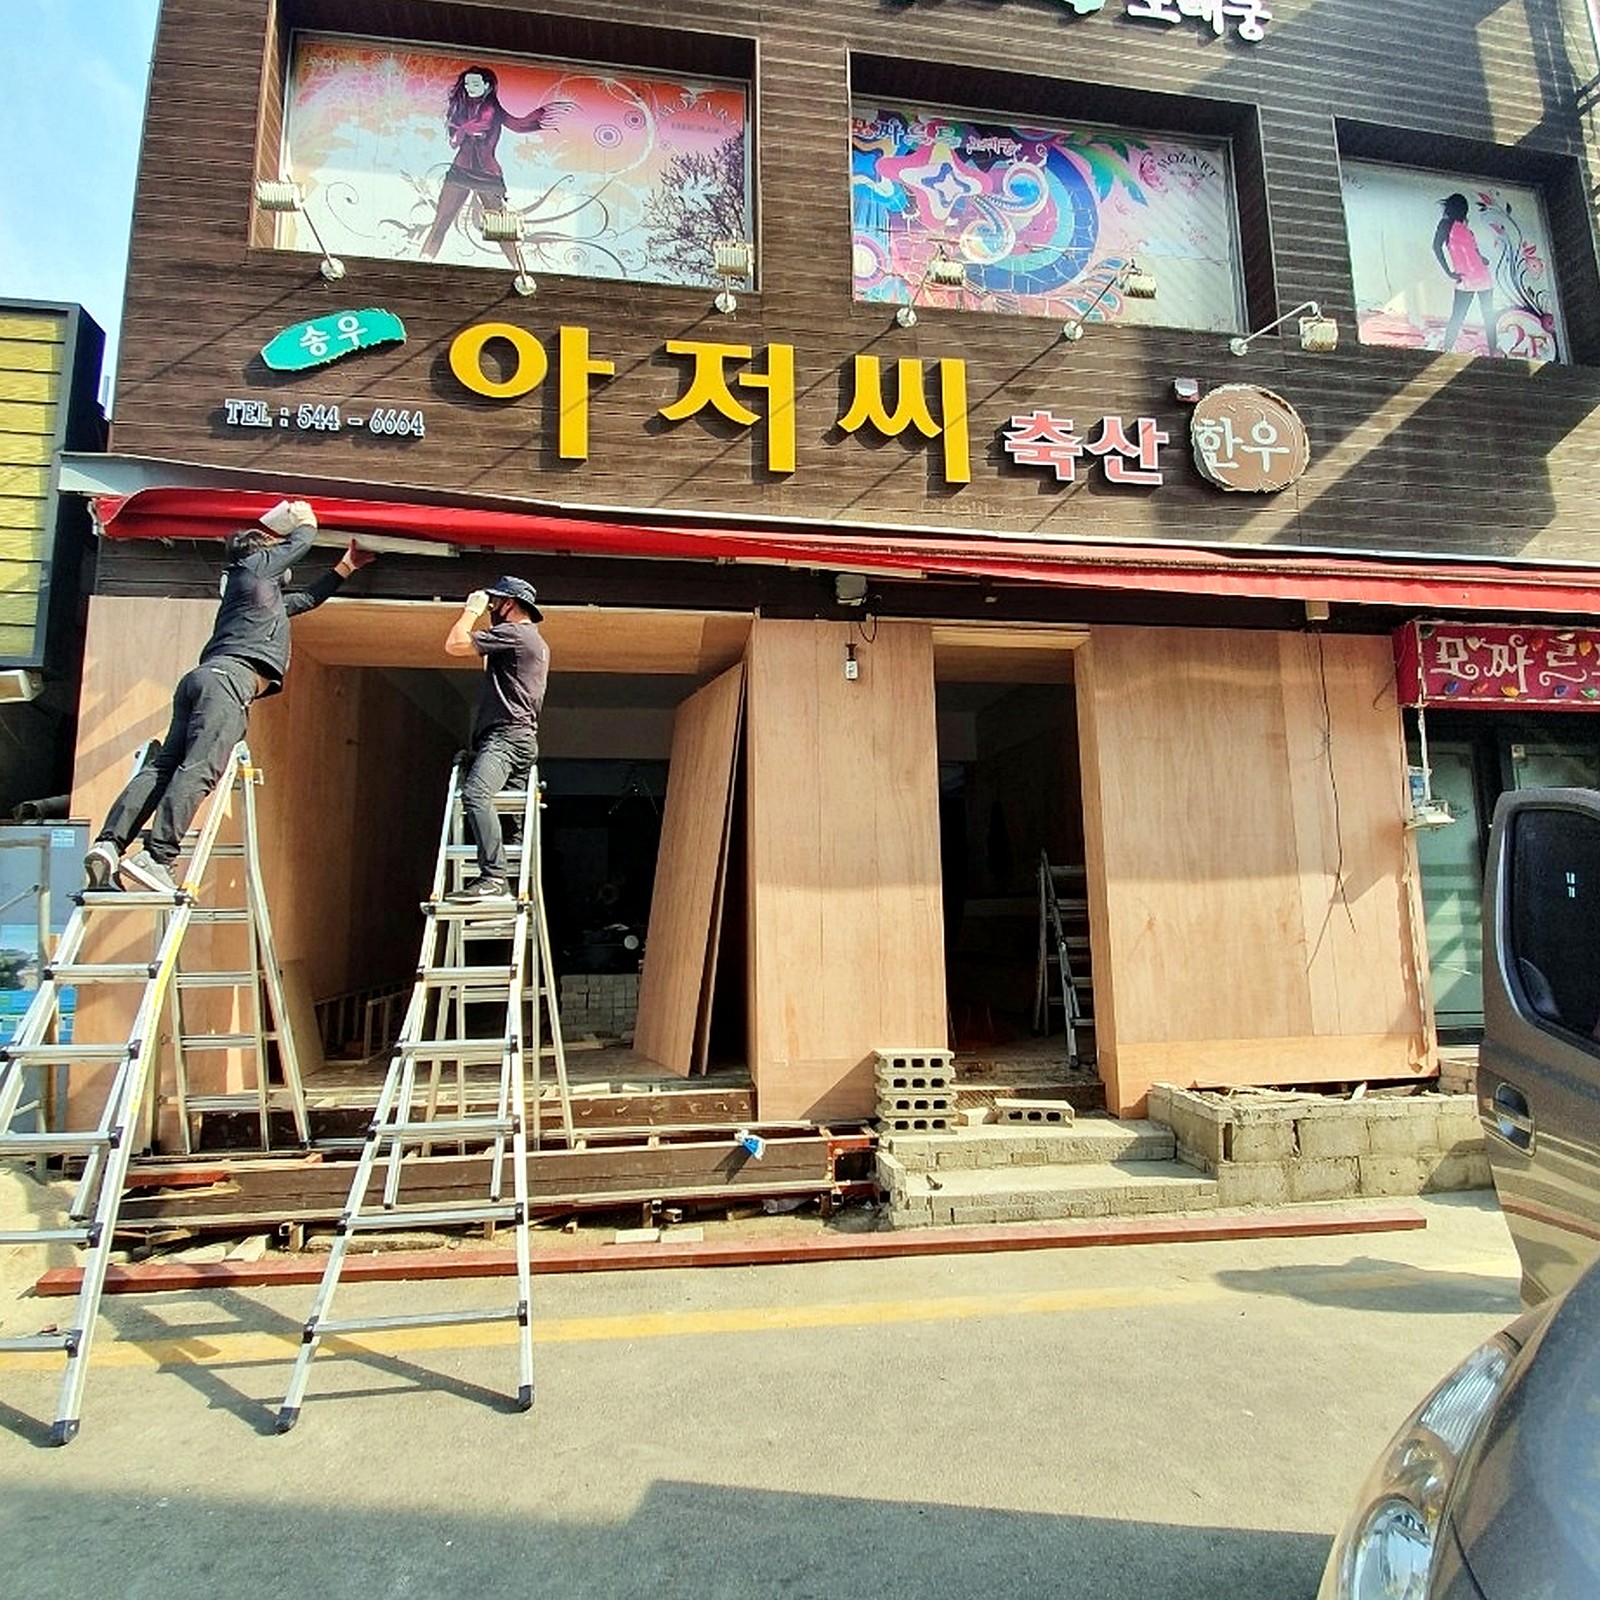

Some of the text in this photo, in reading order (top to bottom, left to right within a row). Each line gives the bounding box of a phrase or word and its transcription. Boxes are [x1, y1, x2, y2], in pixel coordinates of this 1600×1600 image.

[298, 313, 368, 357] 송우
[448, 322, 1169, 486] 아저씨 축산
[1194, 416, 1291, 473] 한우
[1429, 633, 1600, 694] 모짜르
